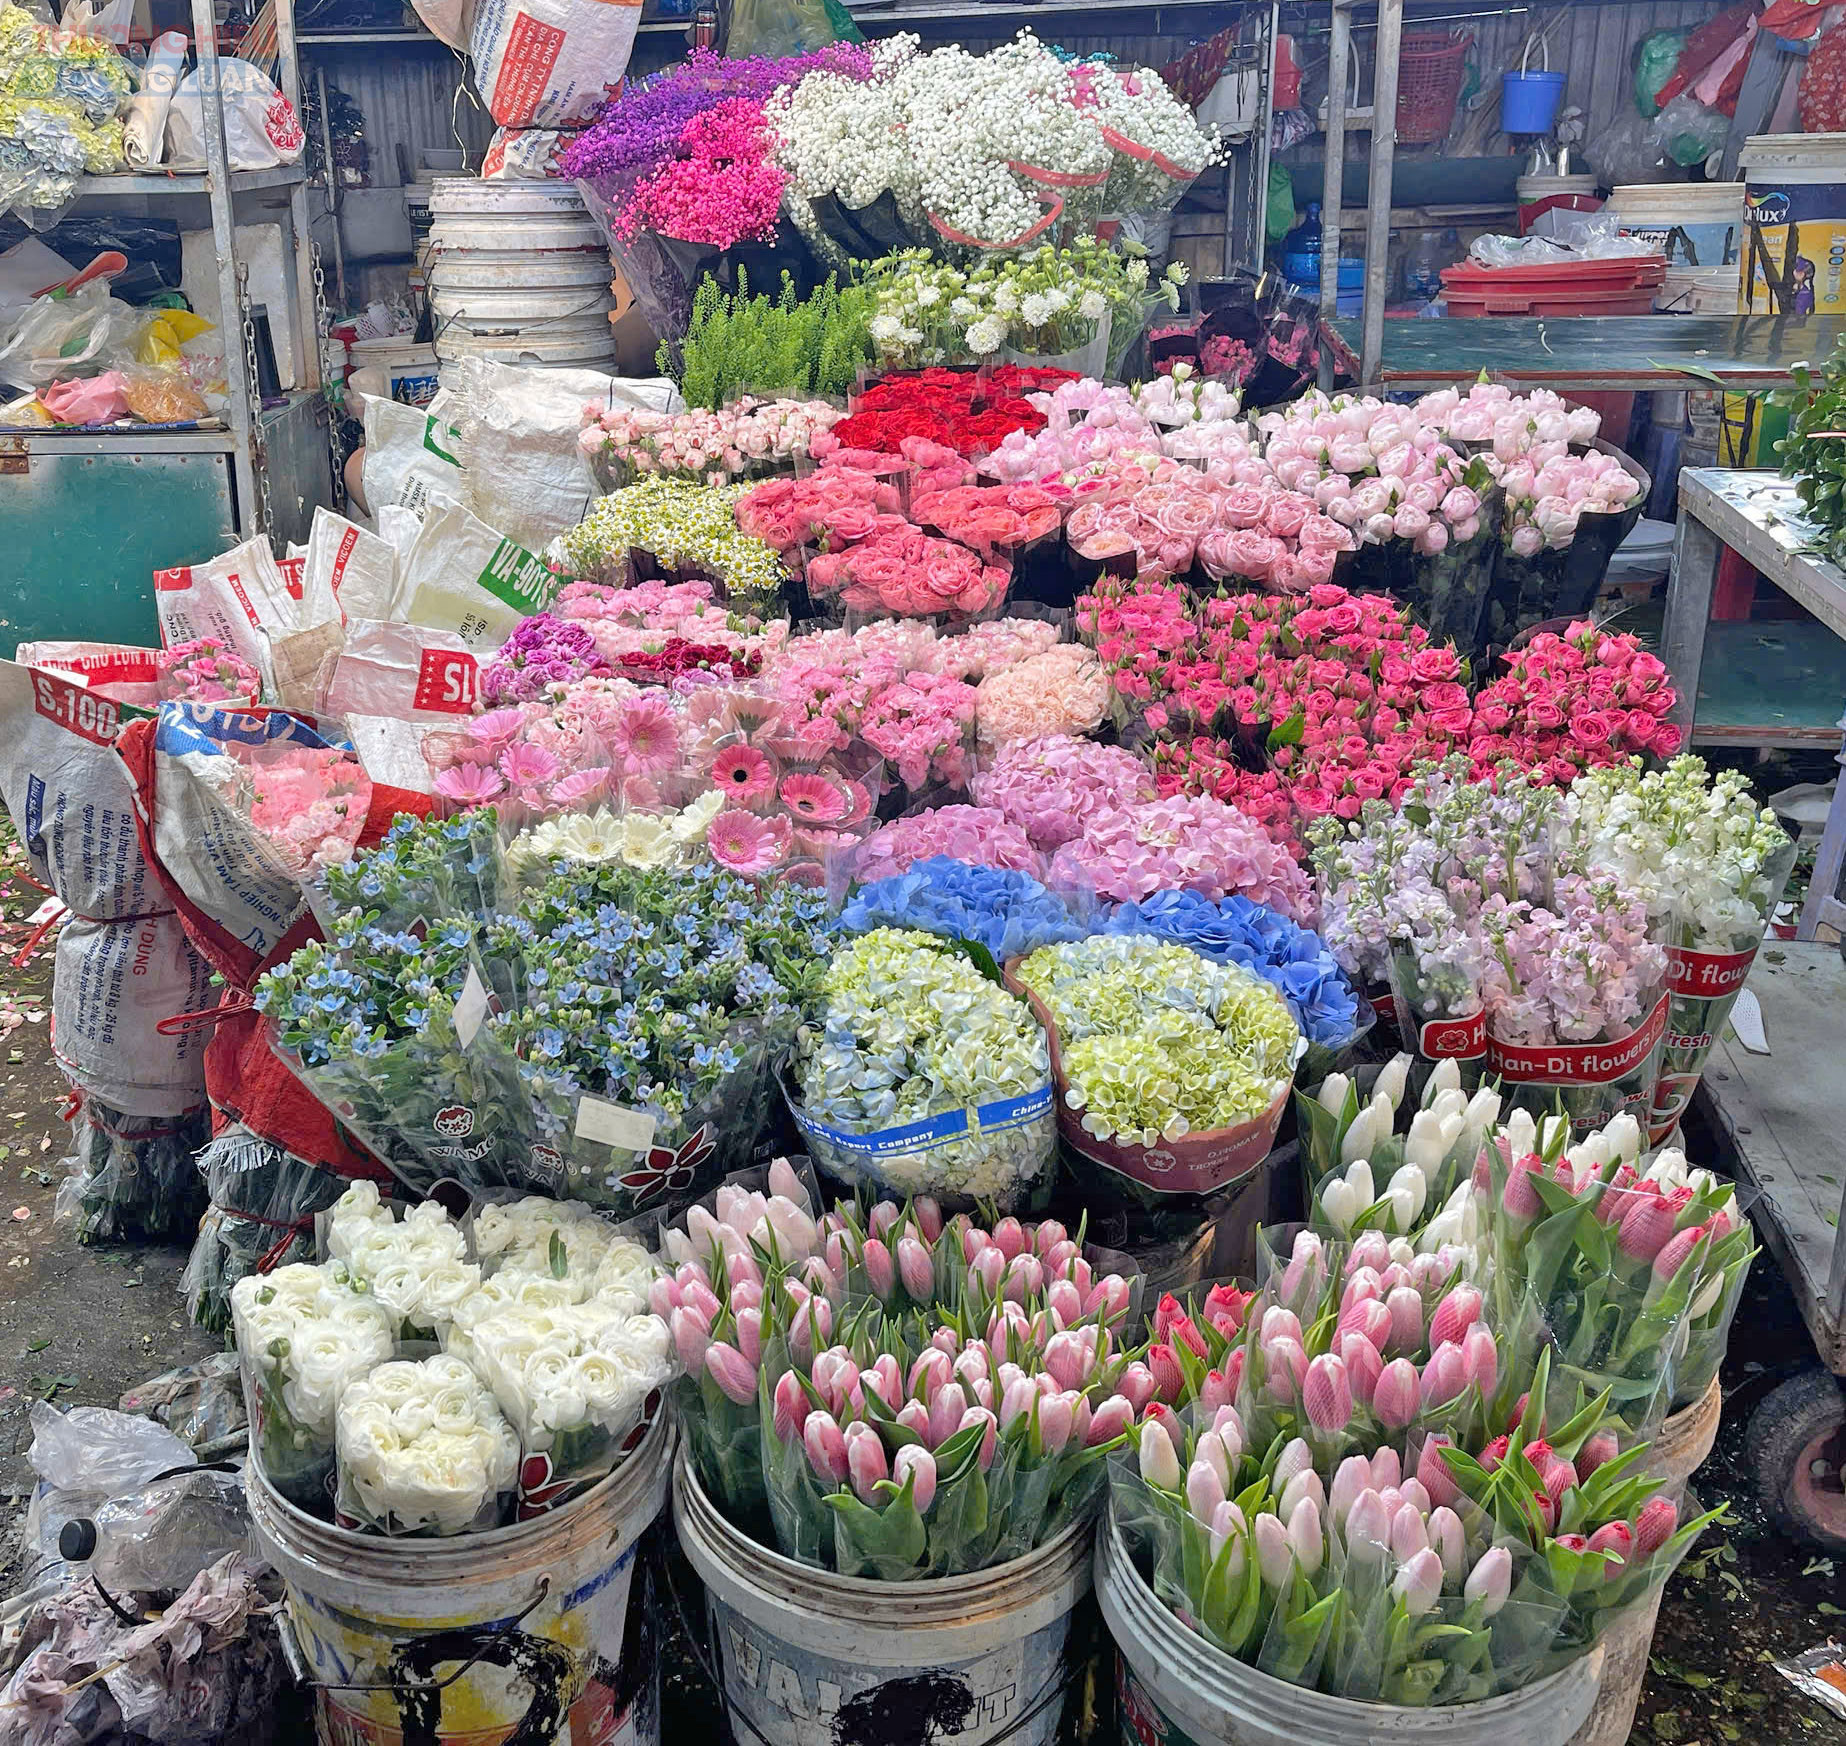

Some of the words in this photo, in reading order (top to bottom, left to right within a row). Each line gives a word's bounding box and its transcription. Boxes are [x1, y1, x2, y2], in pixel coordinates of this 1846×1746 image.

[536, 66, 548, 81] TY
[337, 532, 355, 564] VICOEM
[230, 578, 254, 613] VICOEM
[37, 675, 118, 739] S.100
[1491, 1045, 1574, 1074] Han-Di
[1581, 1033, 1650, 1074] flowers
[878, 1131, 934, 1149] Company
